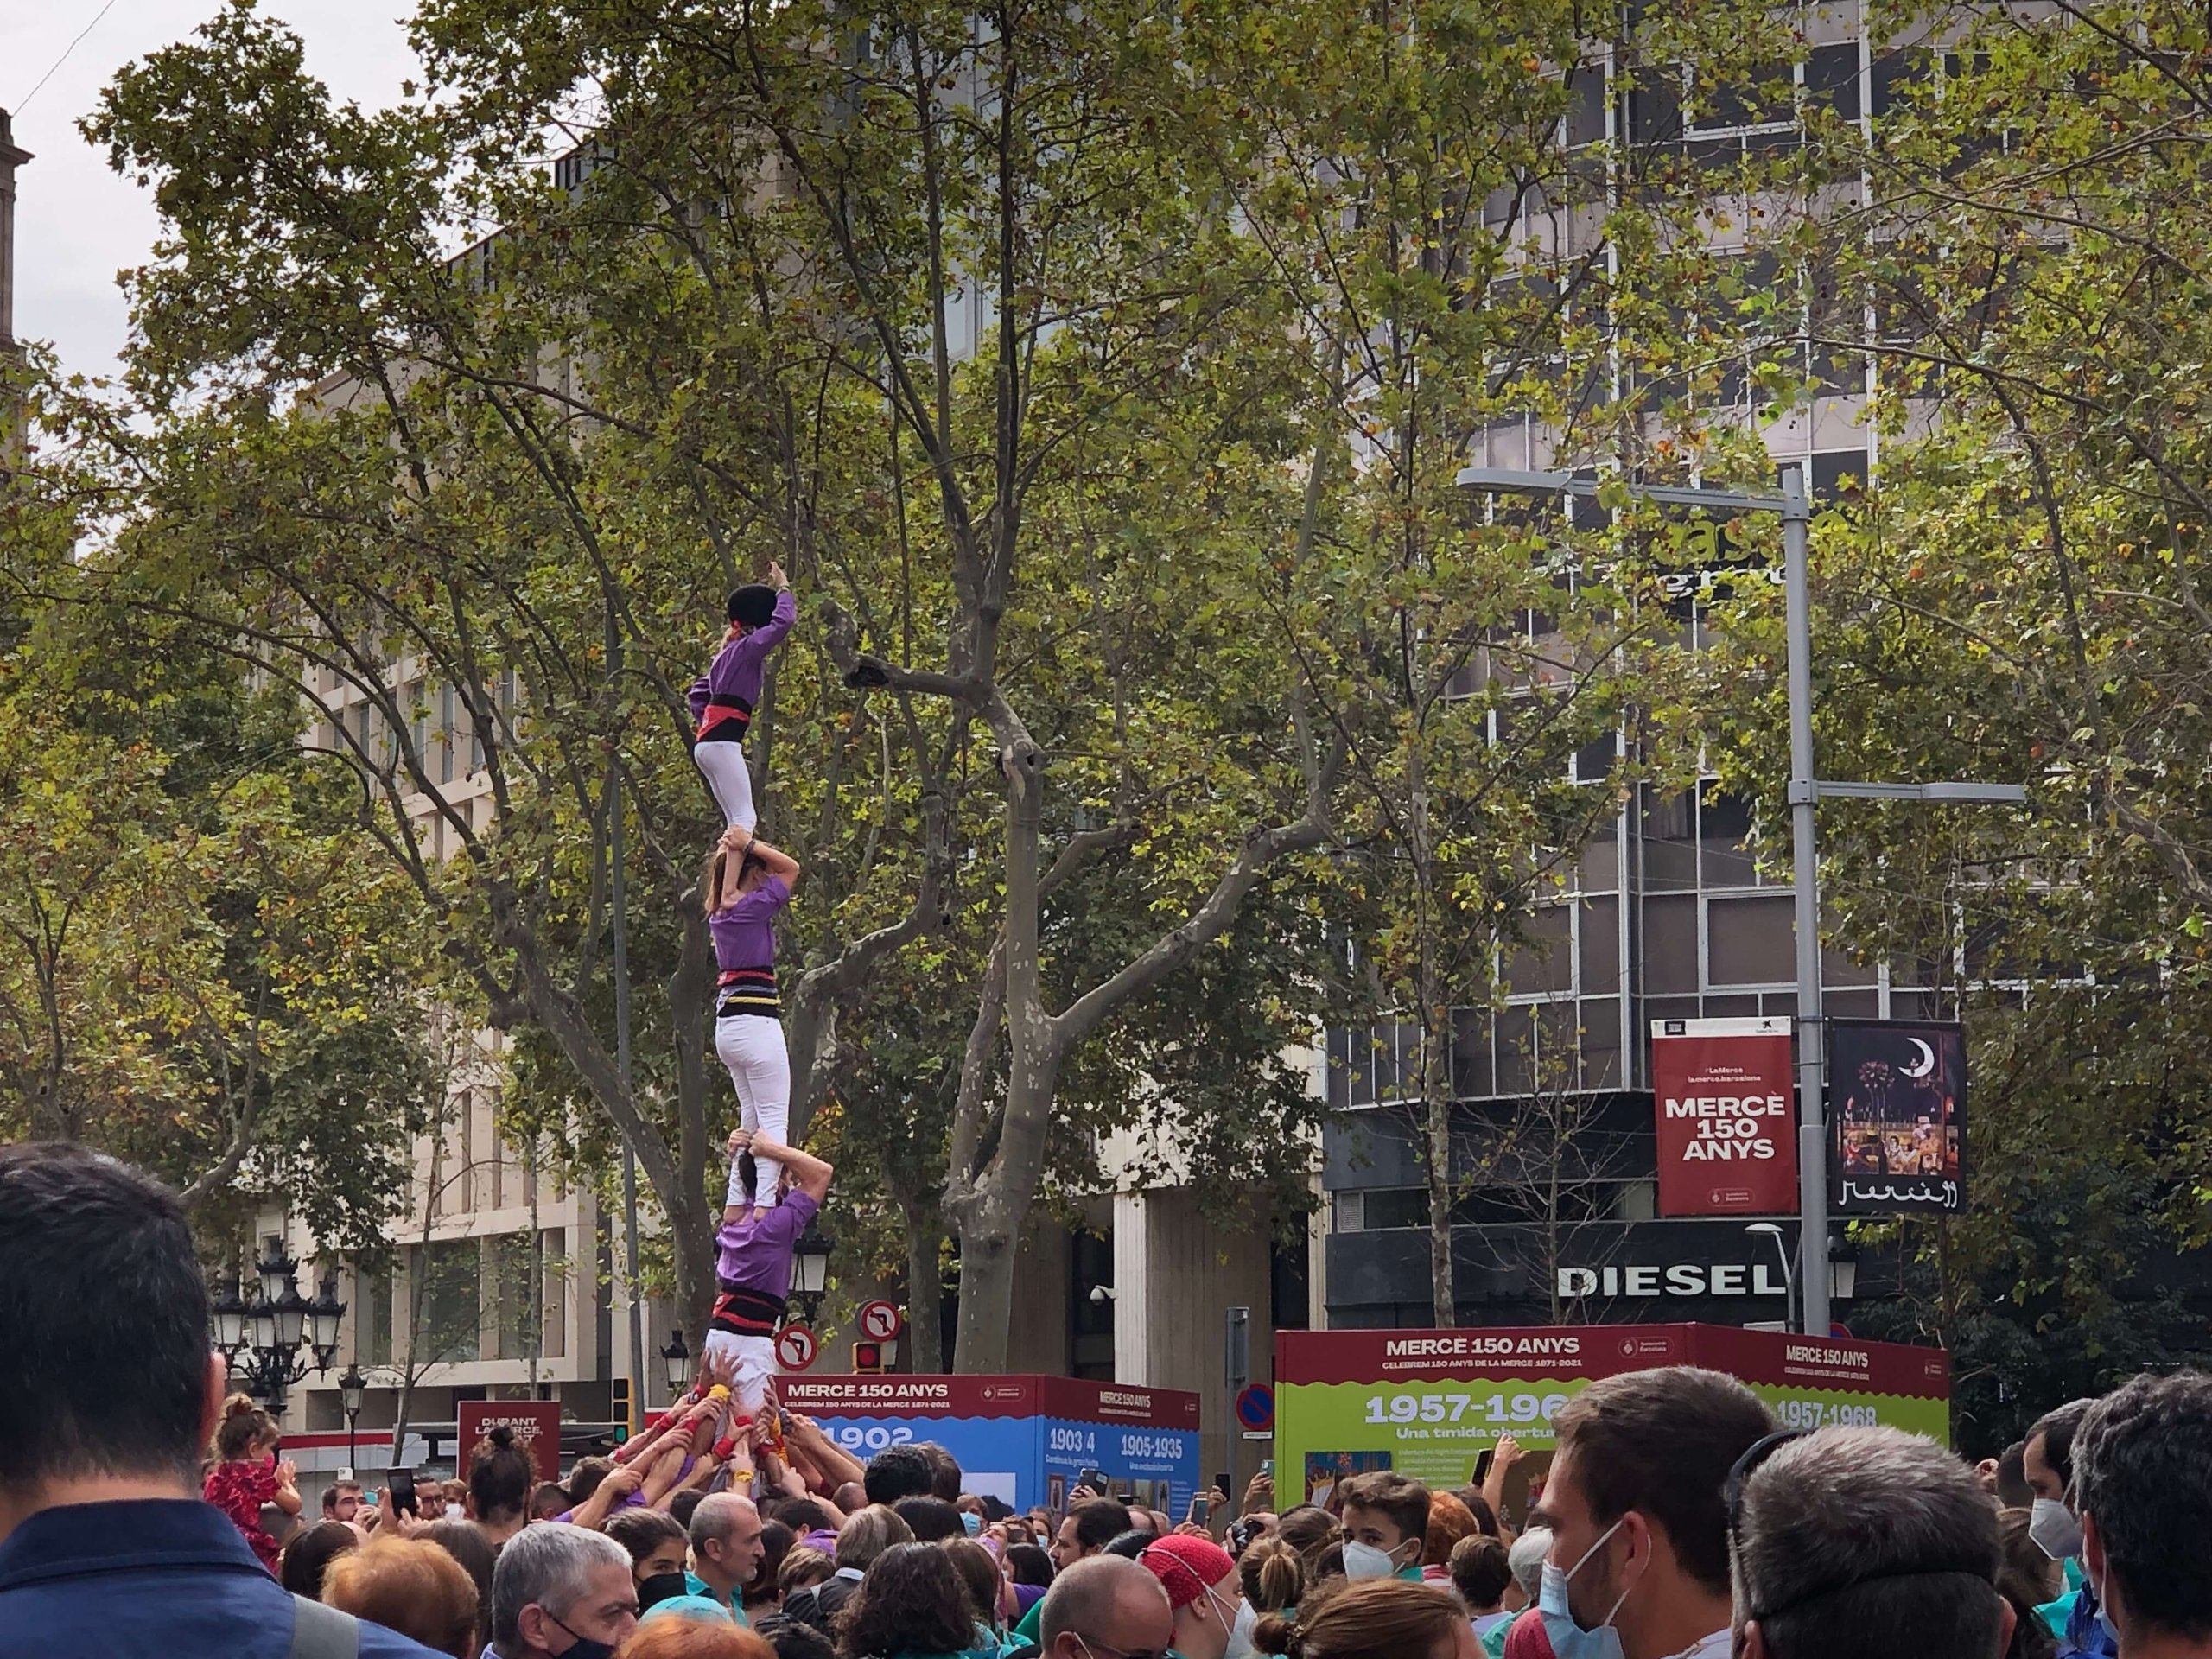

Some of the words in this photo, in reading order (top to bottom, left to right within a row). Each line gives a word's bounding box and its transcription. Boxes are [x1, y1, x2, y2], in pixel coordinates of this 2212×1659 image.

[1664, 1090, 1786, 1118] MERCÈ
[1696, 1117, 1758, 1139] 150
[1682, 1138, 1775, 1161] ANYS
[1557, 1264, 1787, 1297] DIESEL
[1386, 1335, 1468, 1356] MERCÈ
[1471, 1338, 1514, 1355] 150
[1516, 1337, 1580, 1354] ANYS
[1382, 1360, 1431, 1370] CELEBREM
[1448, 1359, 1474, 1368] ANYS
[1822, 1350, 1841, 1365] 150
[1841, 1351, 1869, 1369] ANYS
[858, 1384, 894, 1397] 150
[895, 1383, 949, 1397] ANYS
[1134, 1394, 1152, 1408] ANYS
[1364, 1394, 1570, 1424] 1957-196
[1777, 1400, 1877, 1430] 1957-1968
[822, 1427, 913, 1450] 1902
[1395, 1427, 1430, 1439] Una
[1121, 1434, 1183, 1459] 1905-1935
